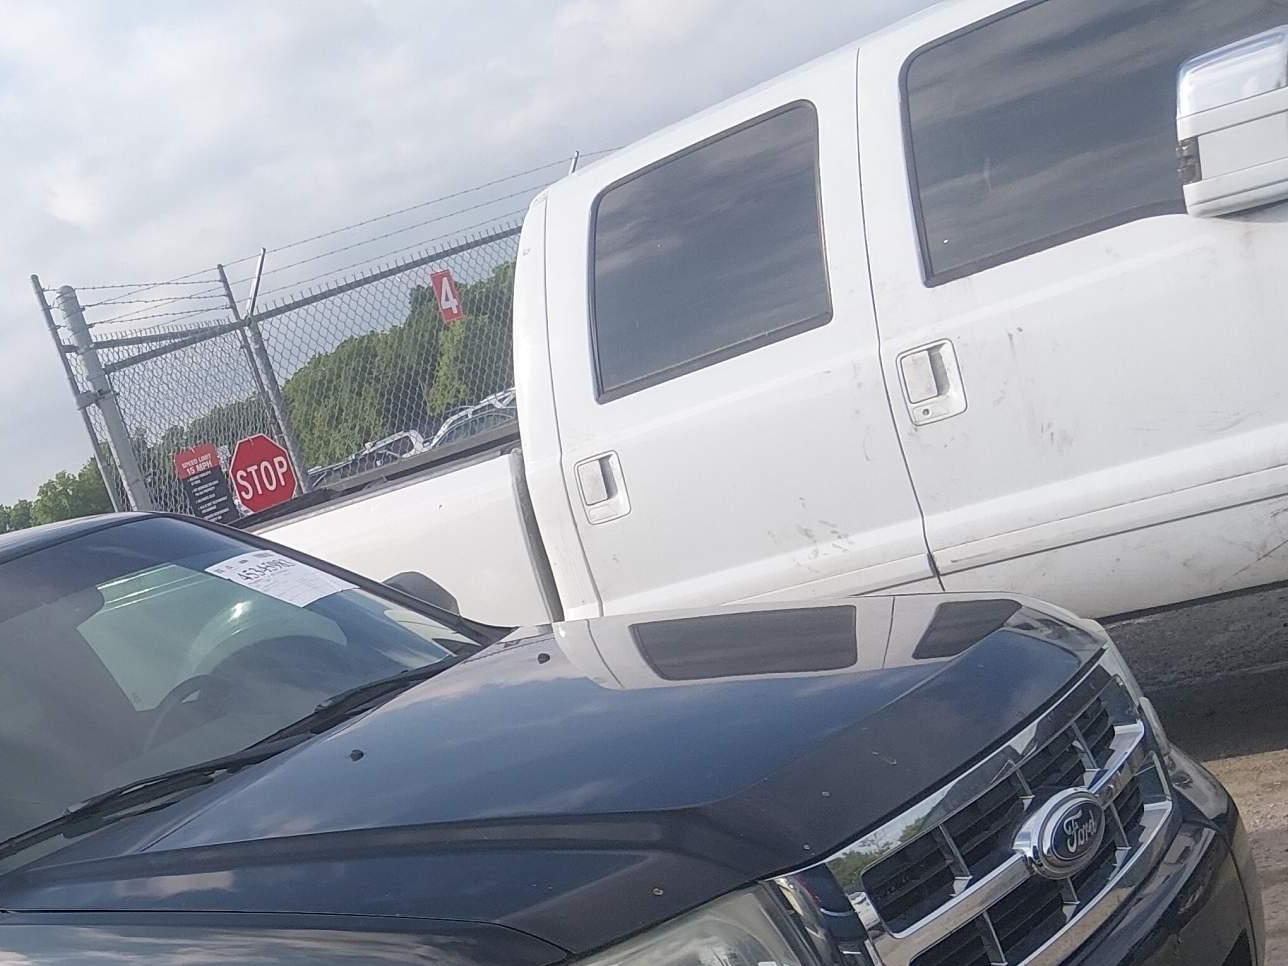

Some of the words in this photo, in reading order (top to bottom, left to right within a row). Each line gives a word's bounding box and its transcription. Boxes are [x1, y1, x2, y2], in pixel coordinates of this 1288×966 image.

[440, 276, 459, 314] 4
[186, 466, 196, 476] 15
[195, 460, 212, 472] MPH
[236, 455, 288, 500] STOP
[1063, 809, 1097, 853] Ford
